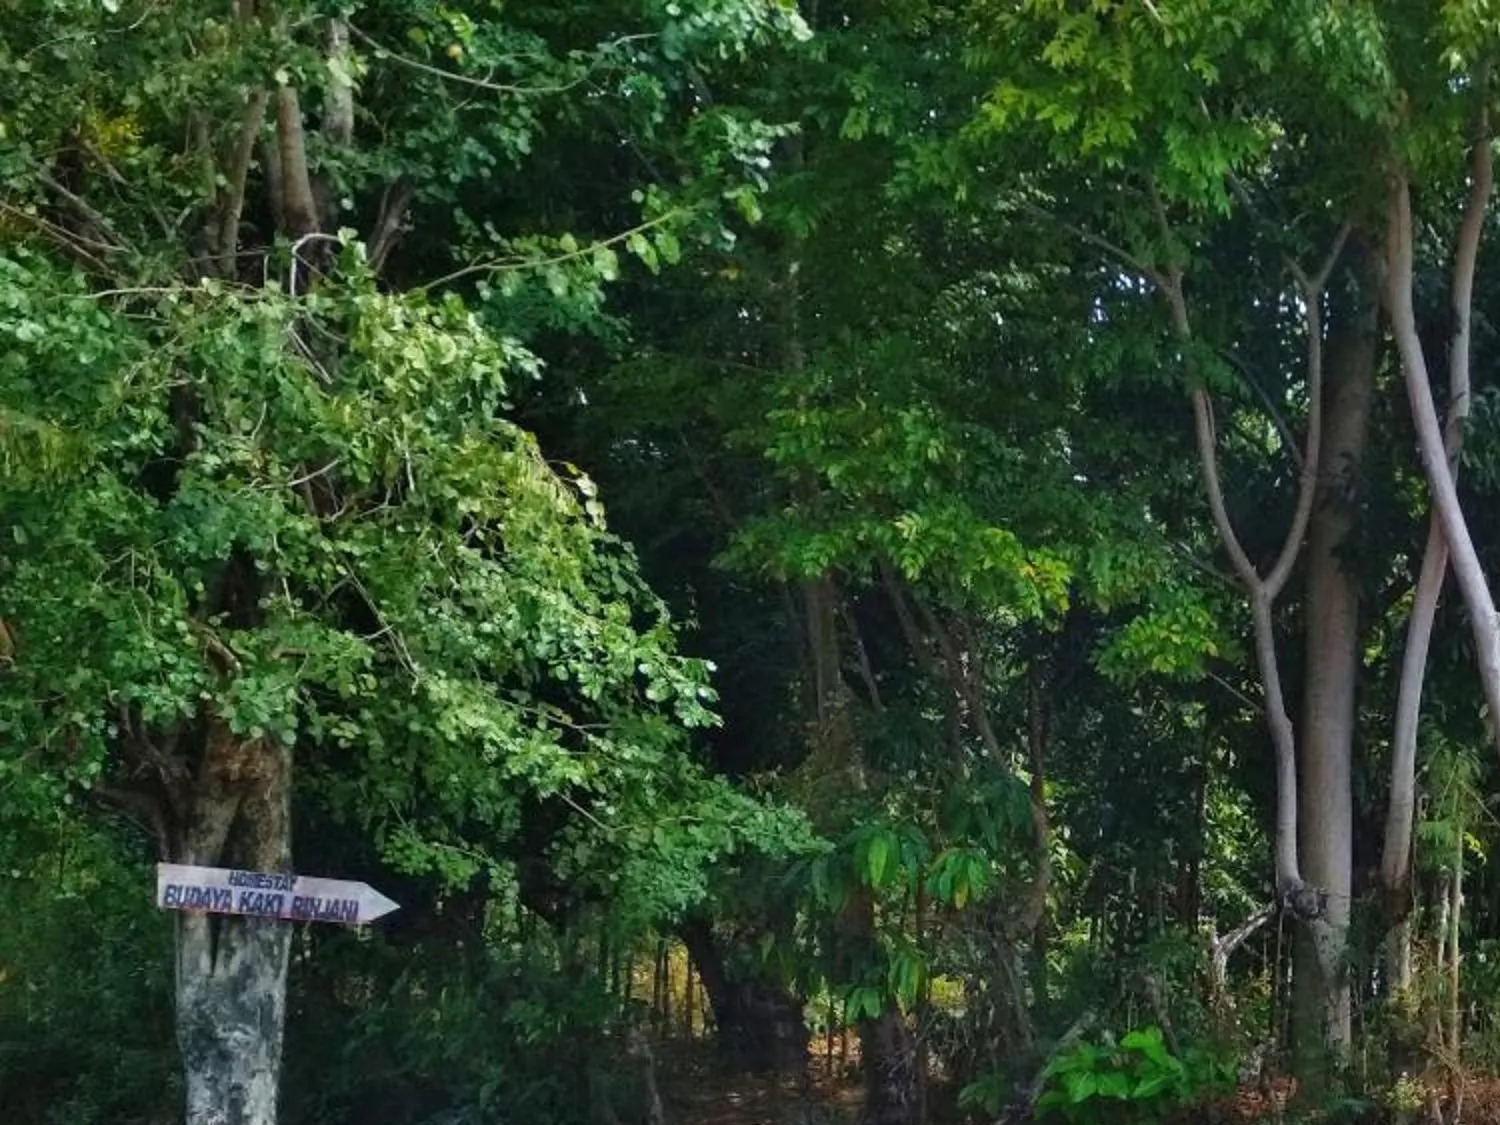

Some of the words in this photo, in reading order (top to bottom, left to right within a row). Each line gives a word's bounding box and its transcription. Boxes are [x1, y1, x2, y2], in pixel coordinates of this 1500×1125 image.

[228, 871, 297, 893] HOMESTAY
[164, 884, 233, 911] BUDAYA
[239, 889, 284, 916] KAKI
